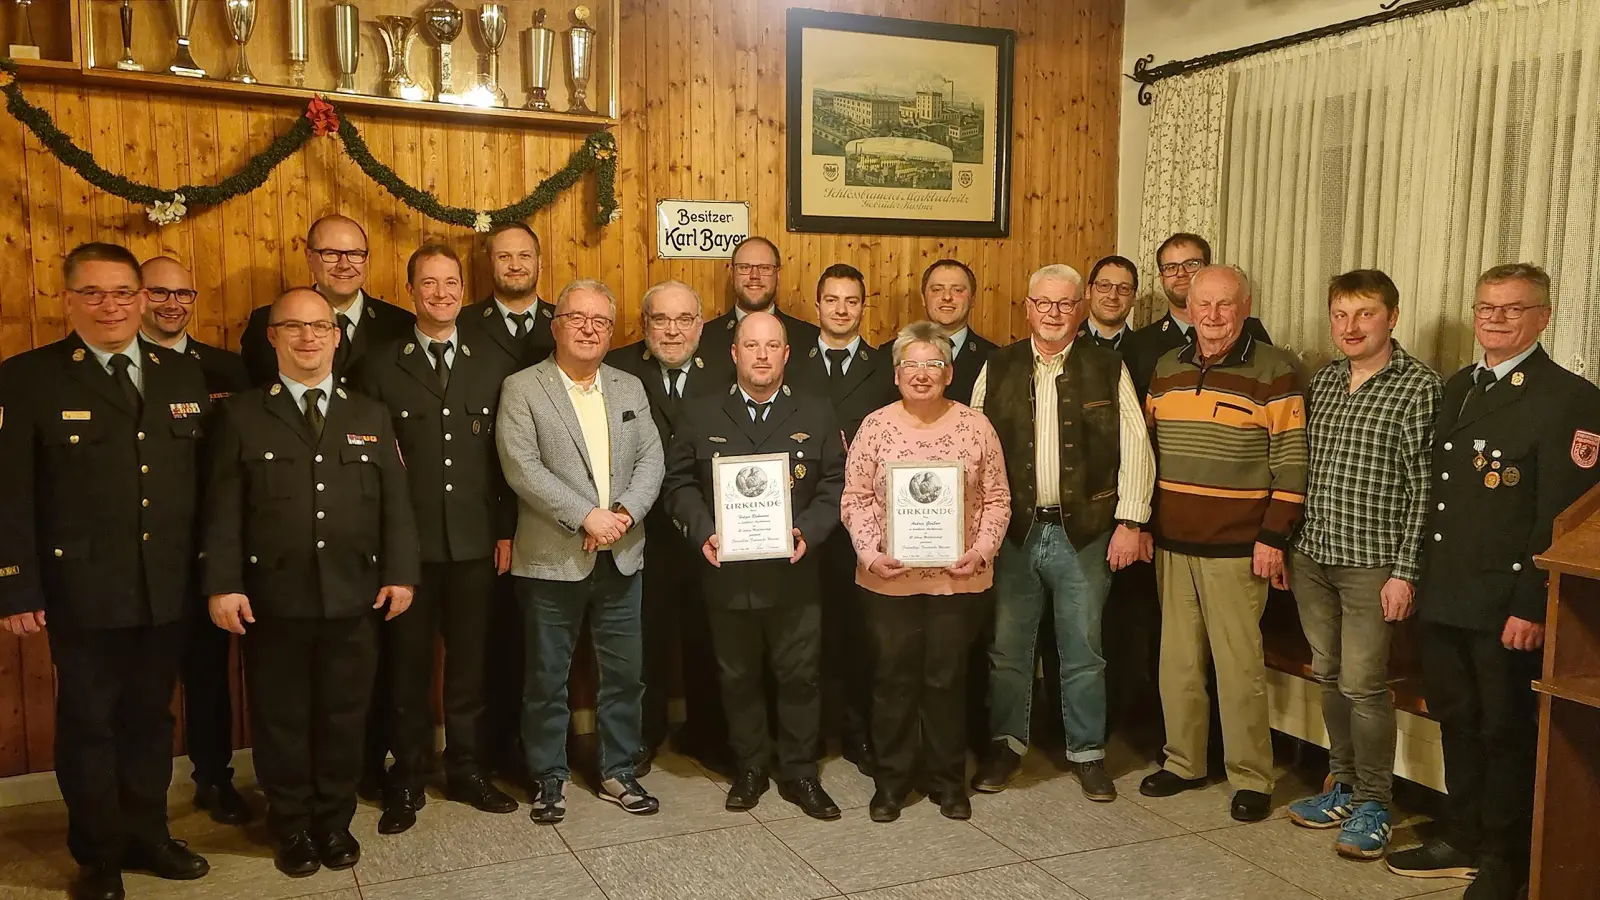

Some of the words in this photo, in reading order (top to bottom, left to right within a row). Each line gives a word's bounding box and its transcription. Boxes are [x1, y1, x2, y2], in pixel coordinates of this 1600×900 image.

[665, 227, 697, 251] Karl
[699, 228, 747, 252] Bayer
[724, 500, 782, 510] URKUNDE
[896, 508, 955, 516] URKUNDE
